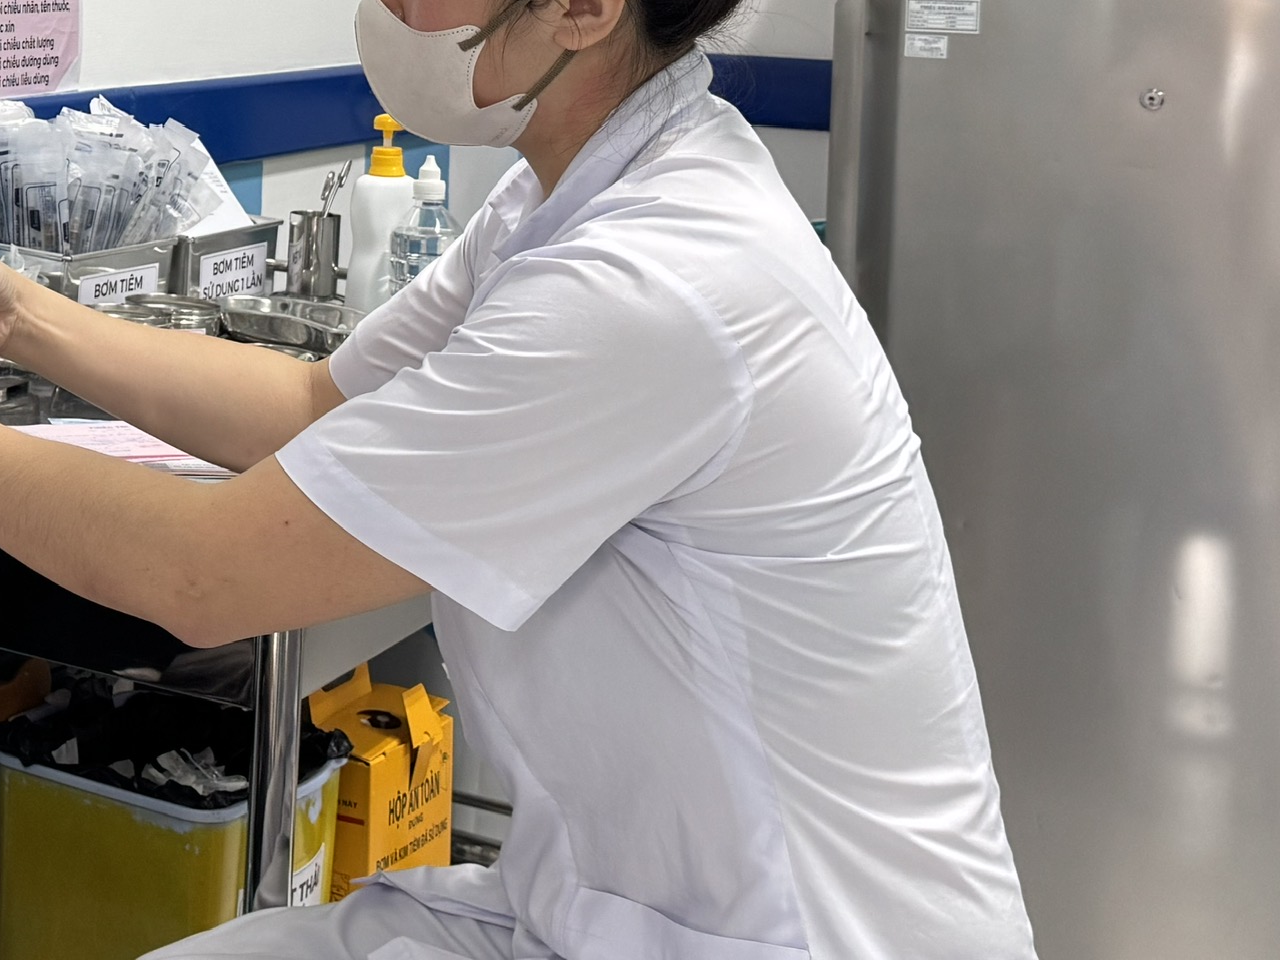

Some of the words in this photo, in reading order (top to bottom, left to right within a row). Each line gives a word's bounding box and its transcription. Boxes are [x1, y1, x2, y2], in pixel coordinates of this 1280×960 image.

[213, 261, 233, 275] BƠM
[234, 252, 254, 269] TIÊM
[94, 282, 117, 298] BƠM
[120, 274, 143, 294] TIÊM
[202, 281, 214, 300] SỬ
[240, 278, 245, 292] 1
[389, 790, 407, 830] HỘP
[408, 787, 420, 815] AN
[420, 770, 440, 806] TOÀN
